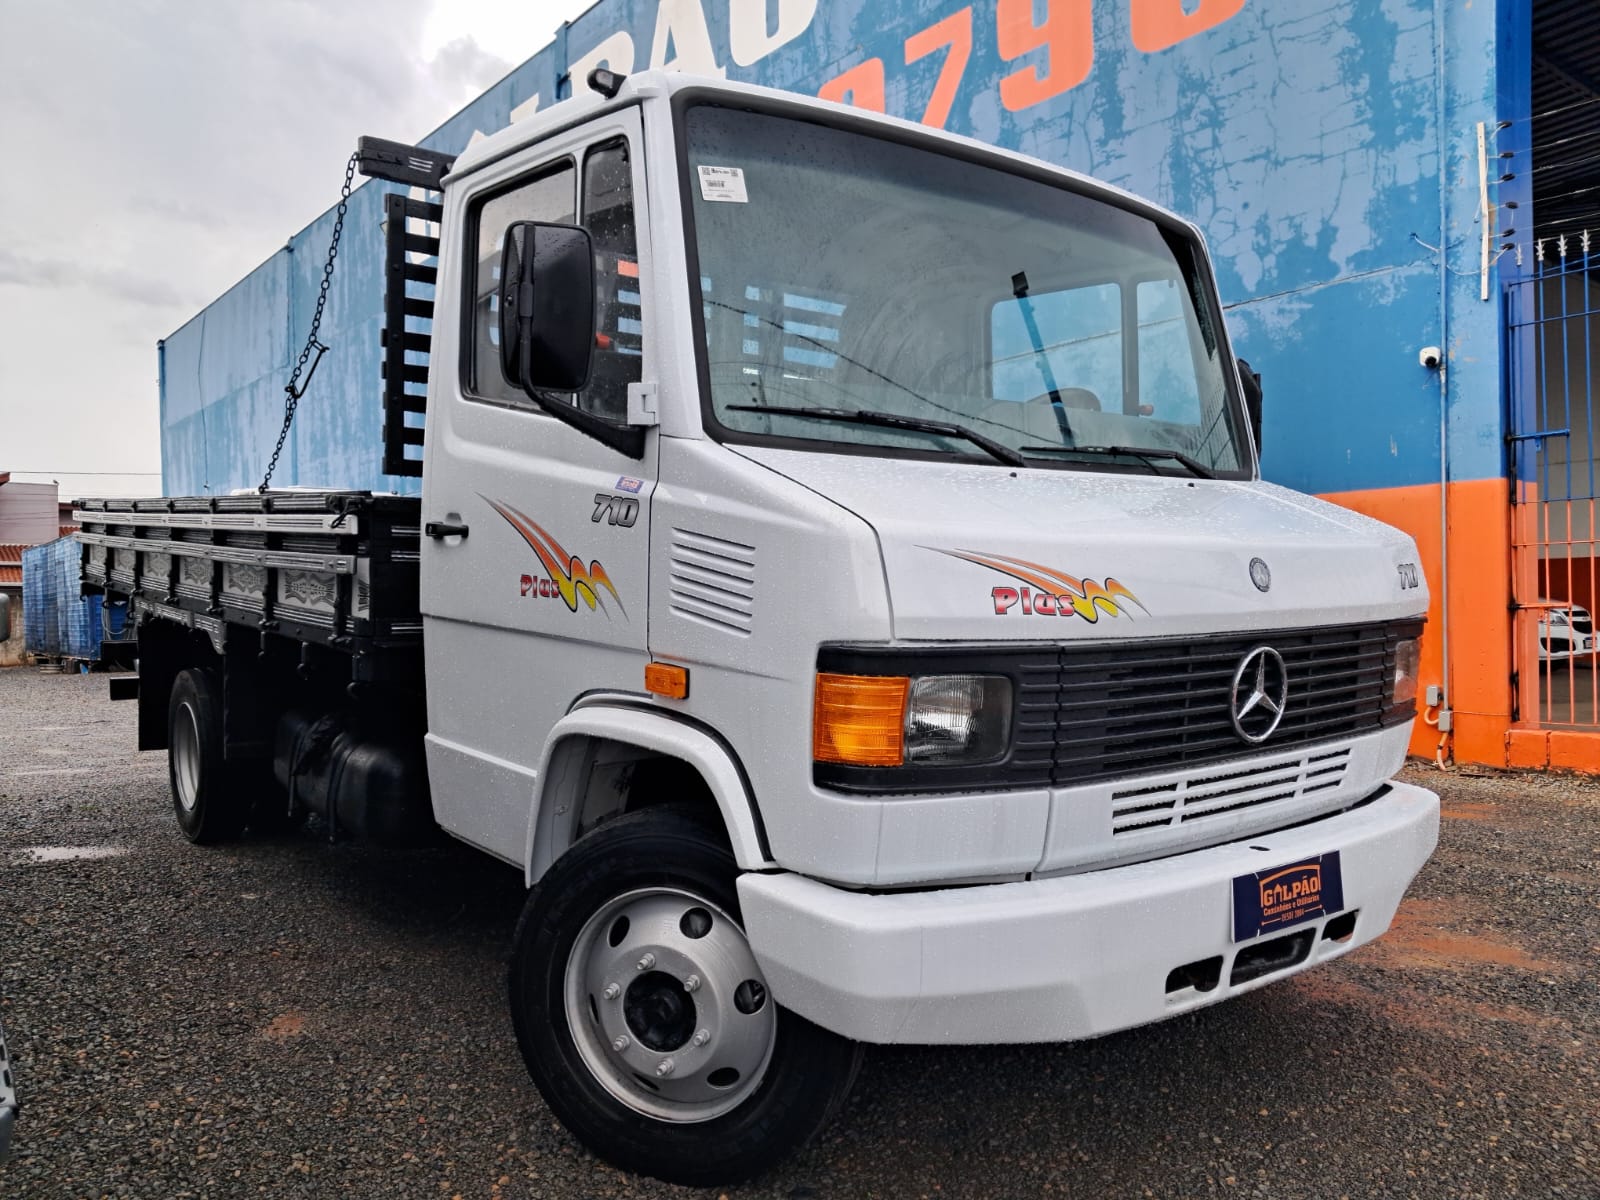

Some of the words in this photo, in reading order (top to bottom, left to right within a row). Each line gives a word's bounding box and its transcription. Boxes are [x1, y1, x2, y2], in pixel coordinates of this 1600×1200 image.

[591, 493, 640, 528] 710
[520, 574, 561, 598] Plus
[1397, 563, 1418, 590] 710
[991, 586, 1076, 616] Plus
